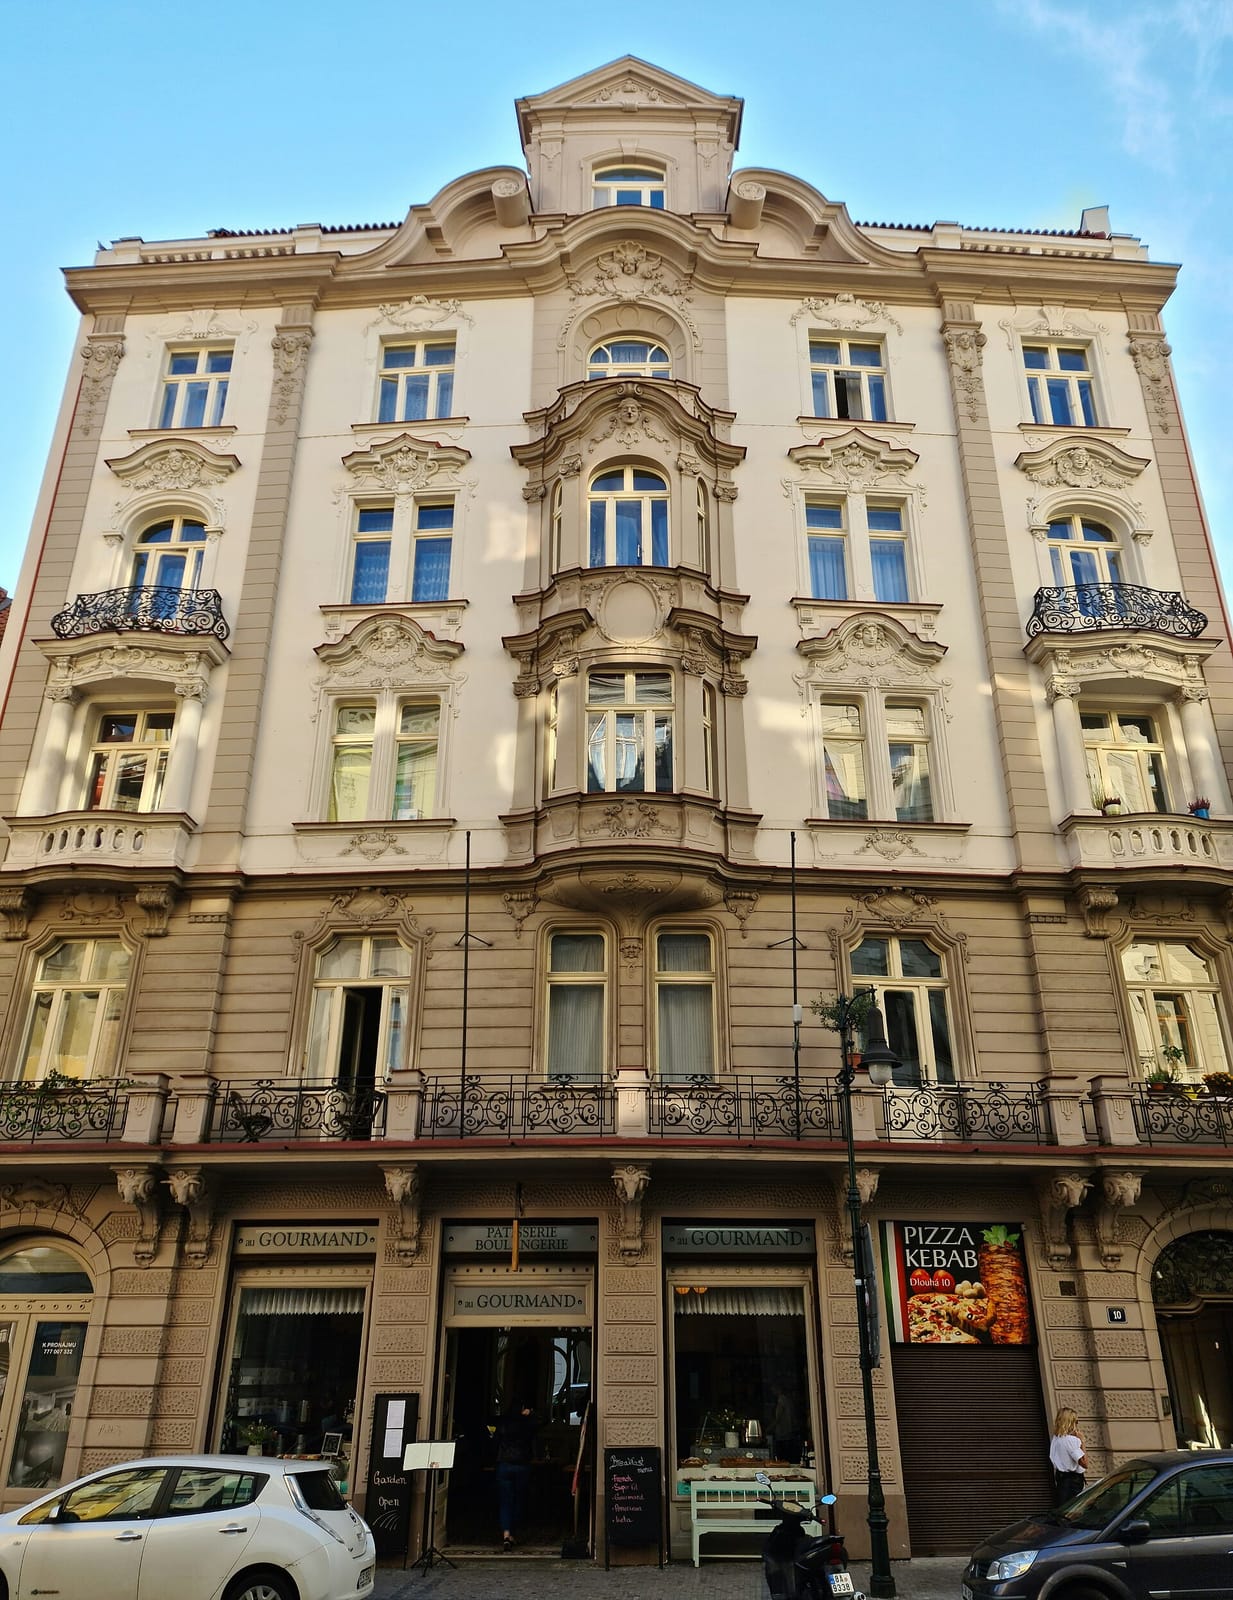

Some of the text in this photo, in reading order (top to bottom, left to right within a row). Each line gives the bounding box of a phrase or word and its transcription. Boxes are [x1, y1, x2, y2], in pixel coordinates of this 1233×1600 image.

[245, 1231, 368, 1247] au GOURMAND
[487, 1227, 557, 1238] PATSSERIE
[691, 1230, 803, 1246] GOURMAND
[904, 1226, 975, 1246] PIZZA
[475, 1239, 568, 1250] BOULNGERIE
[905, 1249, 978, 1268] KEBAB
[909, 1278, 951, 1287] Dlouhá 10
[477, 1294, 576, 1308] GOURMAND
[1113, 1310, 1122, 1320] 10
[373, 1470, 407, 1486] Garden
[378, 1496, 400, 1510] Open
